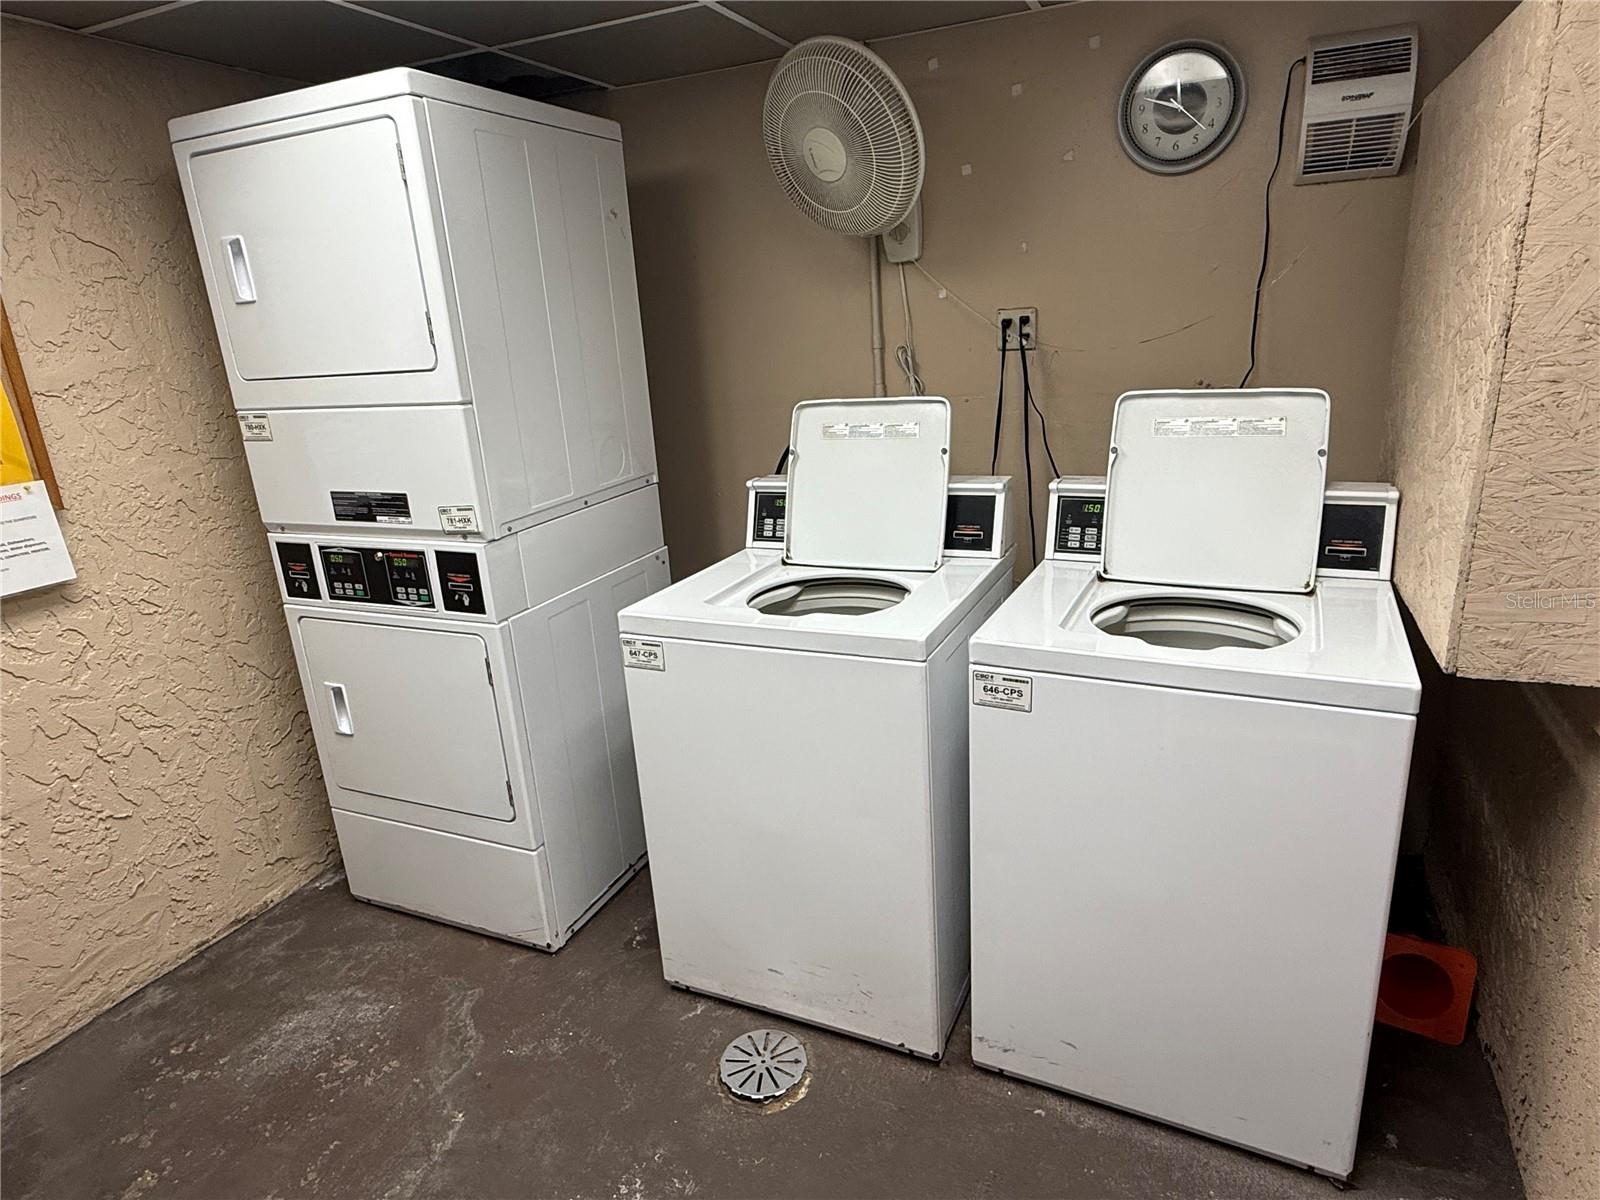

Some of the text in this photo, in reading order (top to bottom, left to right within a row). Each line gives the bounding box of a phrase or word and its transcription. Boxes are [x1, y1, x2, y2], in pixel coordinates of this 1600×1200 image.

[1216, 97, 1223, 108] 3
[1138, 104, 1146, 115] 9
[1208, 117, 1215, 129] 4
[1142, 124, 1149, 134] 8
[1154, 136, 1161, 147] 7
[1191, 133, 1199, 145] 5
[1172, 141, 1180, 152] 6
[446, 517, 473, 525] 781-HXK
[629, 650, 659, 659] 647-CPS
[983, 685, 1024, 698] 646-CPS
